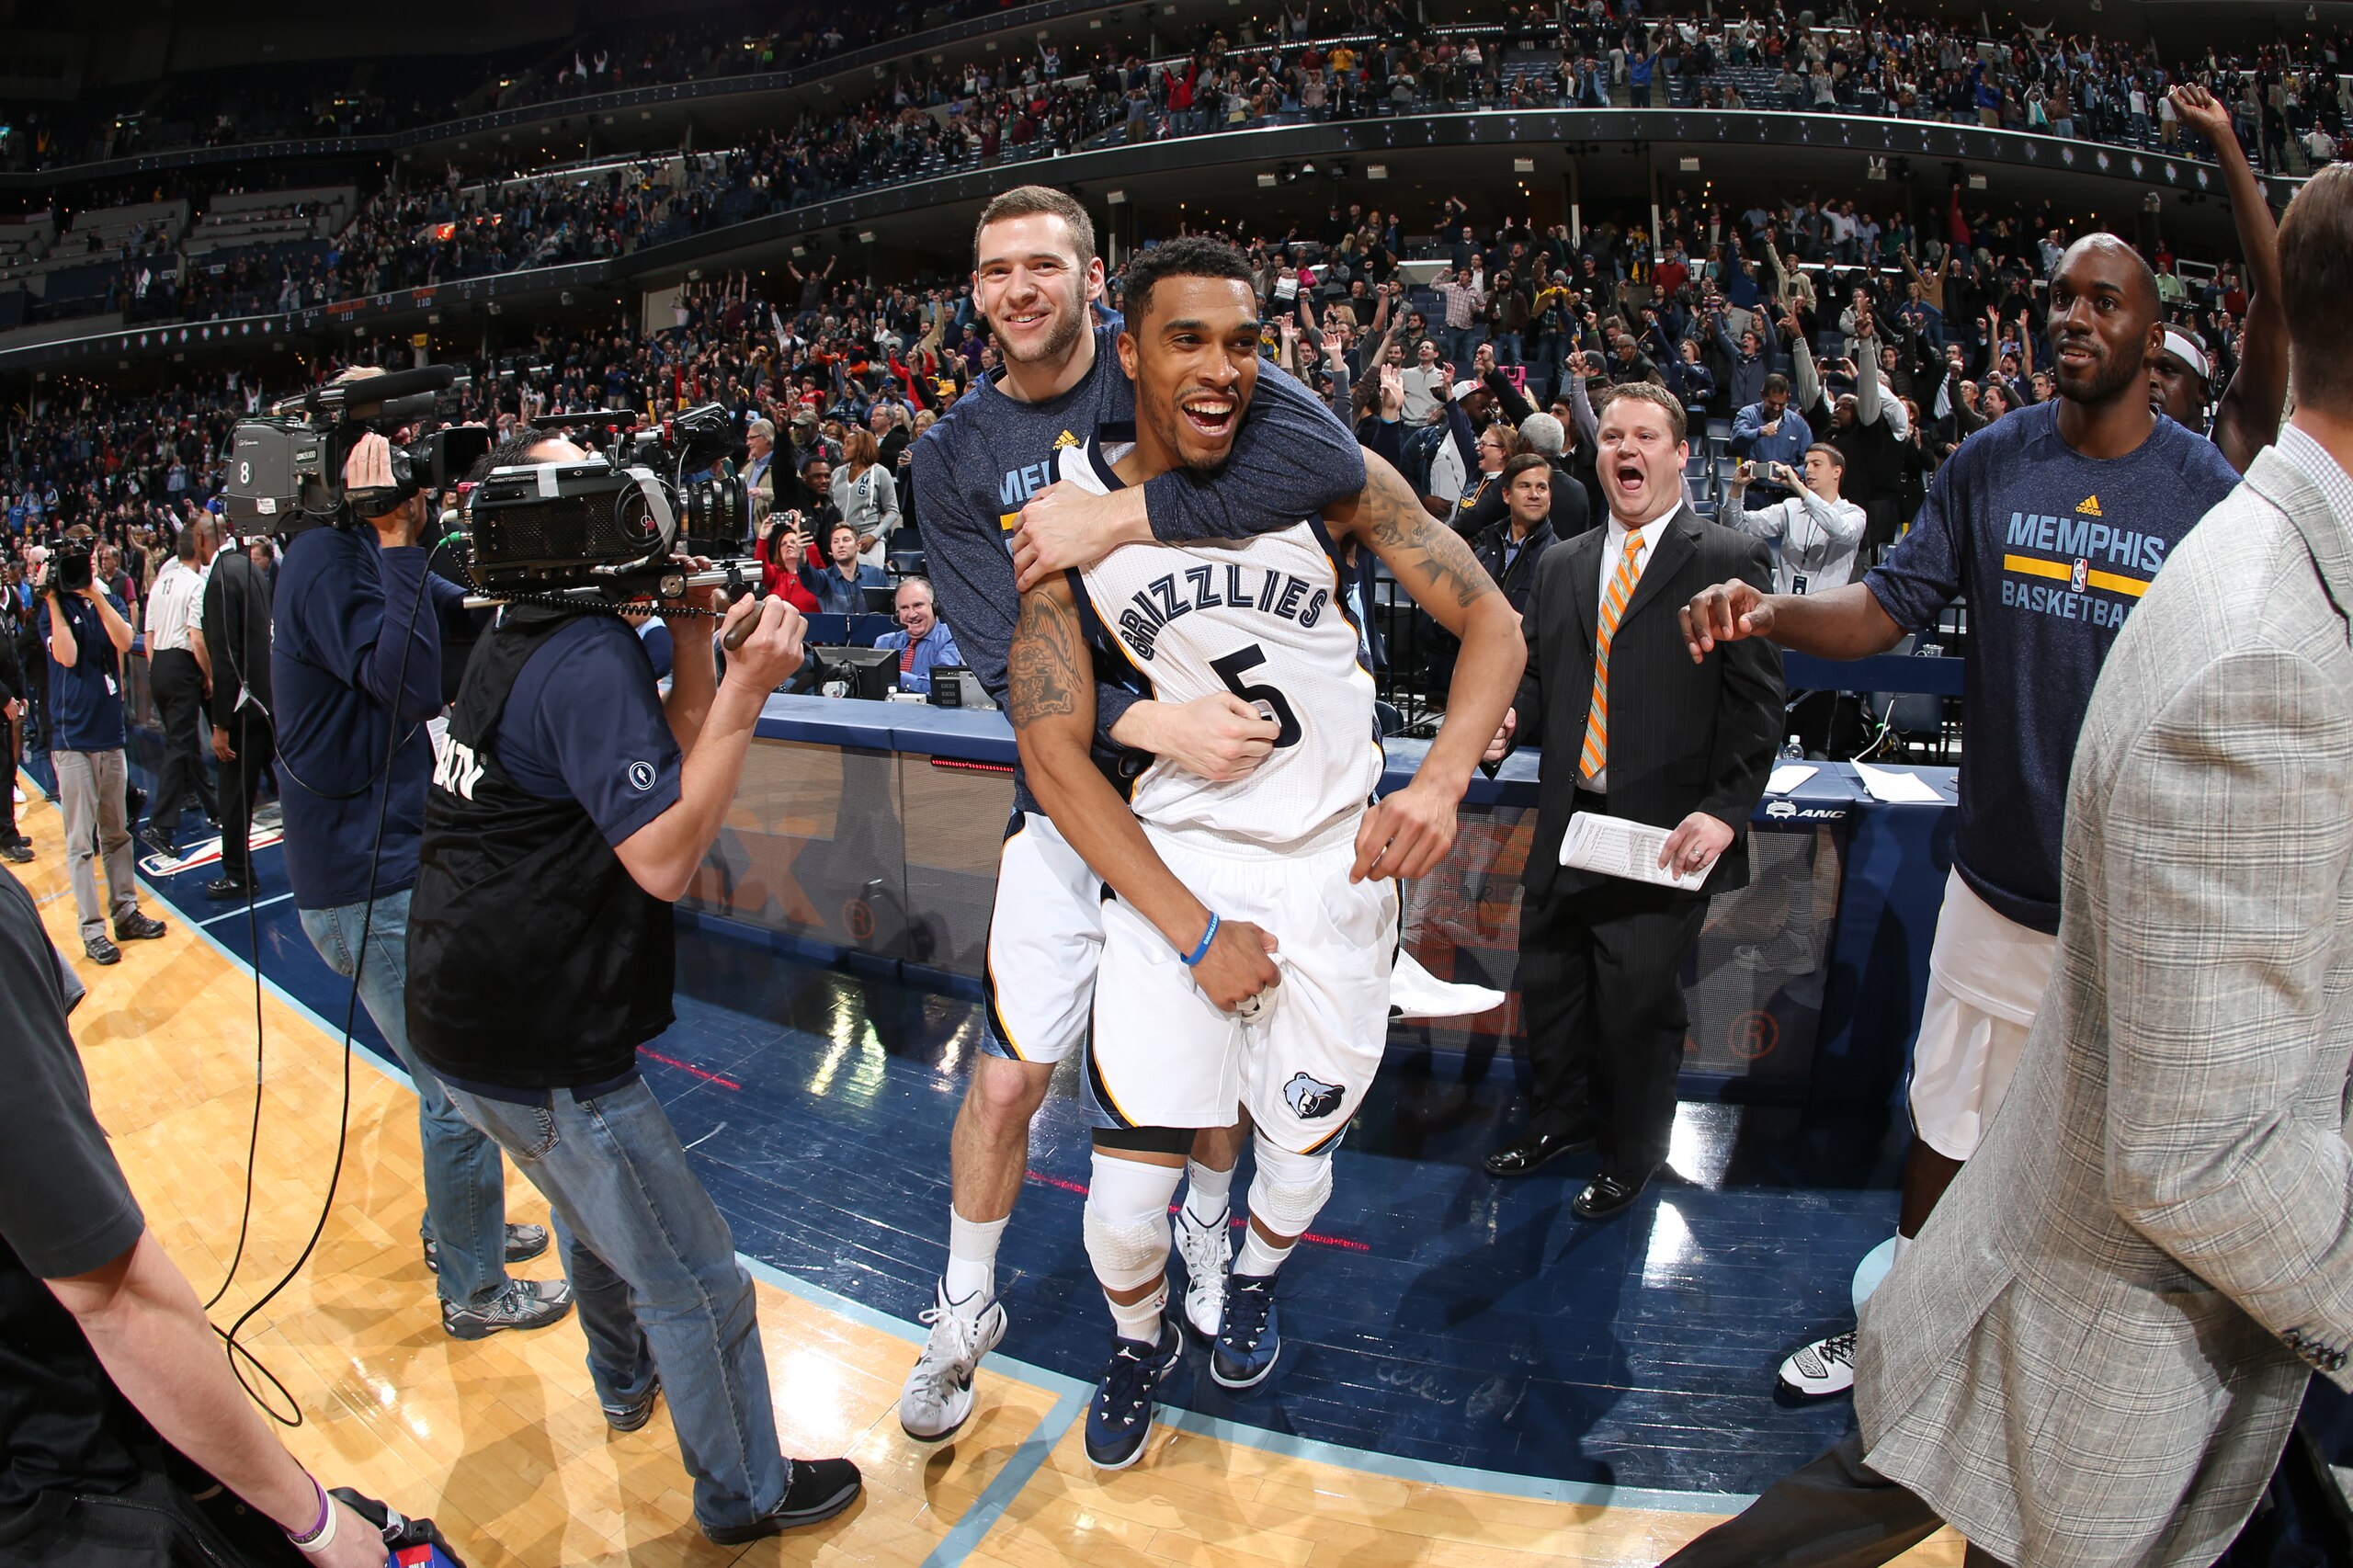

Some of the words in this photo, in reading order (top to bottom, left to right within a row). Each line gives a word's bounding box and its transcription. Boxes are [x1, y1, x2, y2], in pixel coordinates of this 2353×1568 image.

[241, 461, 250, 484] 8
[2075, 506, 2102, 517] adidas
[2006, 512, 2165, 574] MEMPHIS
[162, 577, 174, 595] 13
[1119, 563, 1328, 662] GRIZZLIES
[2002, 580, 2135, 631] BASKETBA
[1209, 643, 1302, 748] 5
[1796, 809, 1847, 819] ANC
